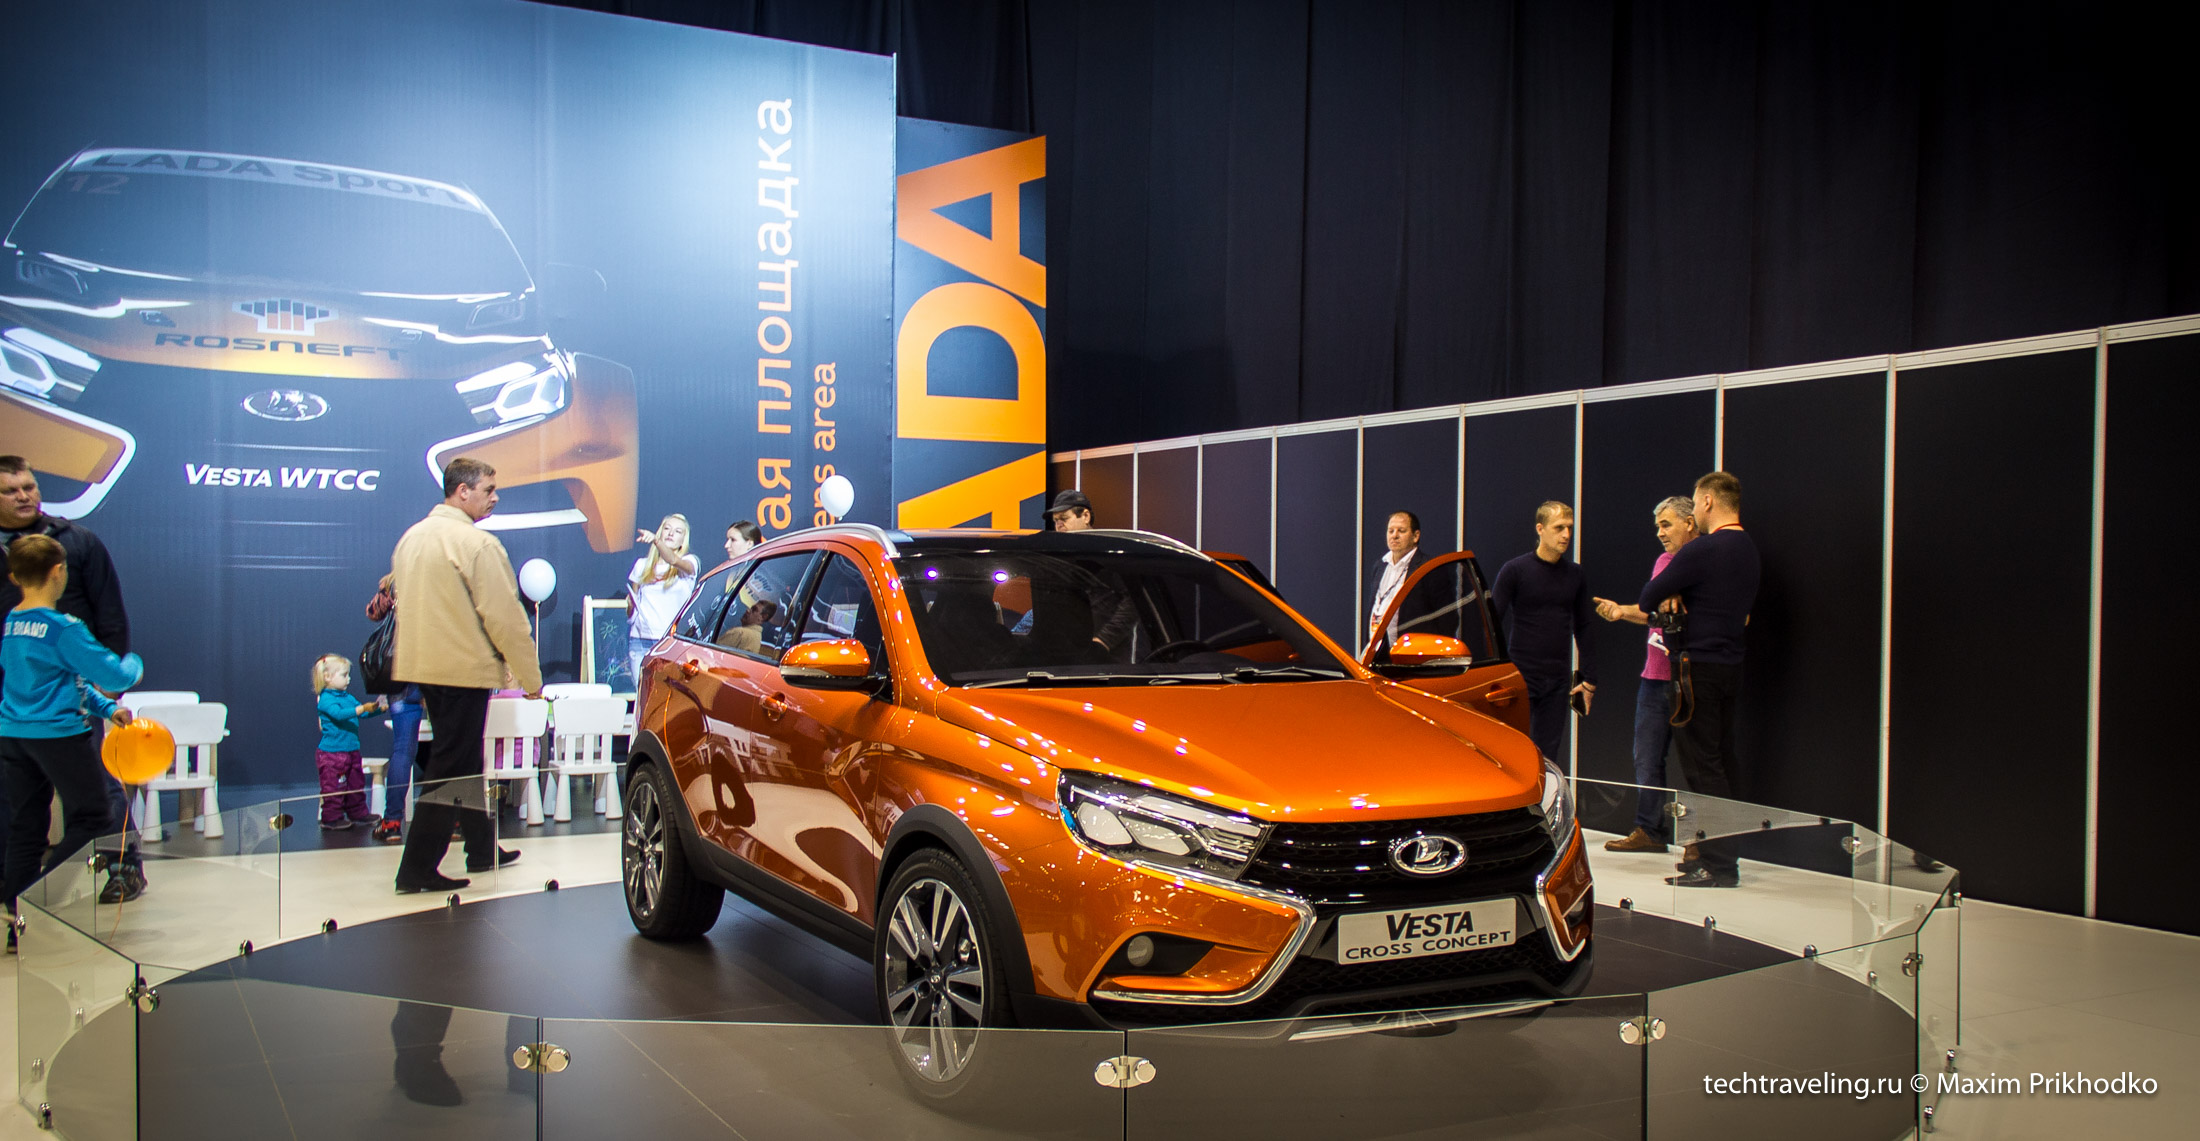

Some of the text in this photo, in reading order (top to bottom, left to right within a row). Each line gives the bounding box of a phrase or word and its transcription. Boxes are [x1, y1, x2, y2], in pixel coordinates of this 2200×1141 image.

[92, 153, 276, 178] LADA
[757, 98, 799, 434] площадка
[813, 362, 836, 452] area
[279, 467, 381, 492] WTCC
[757, 458, 792, 543] ая
[1345, 931, 1511, 960] CROSS CONCEPT
